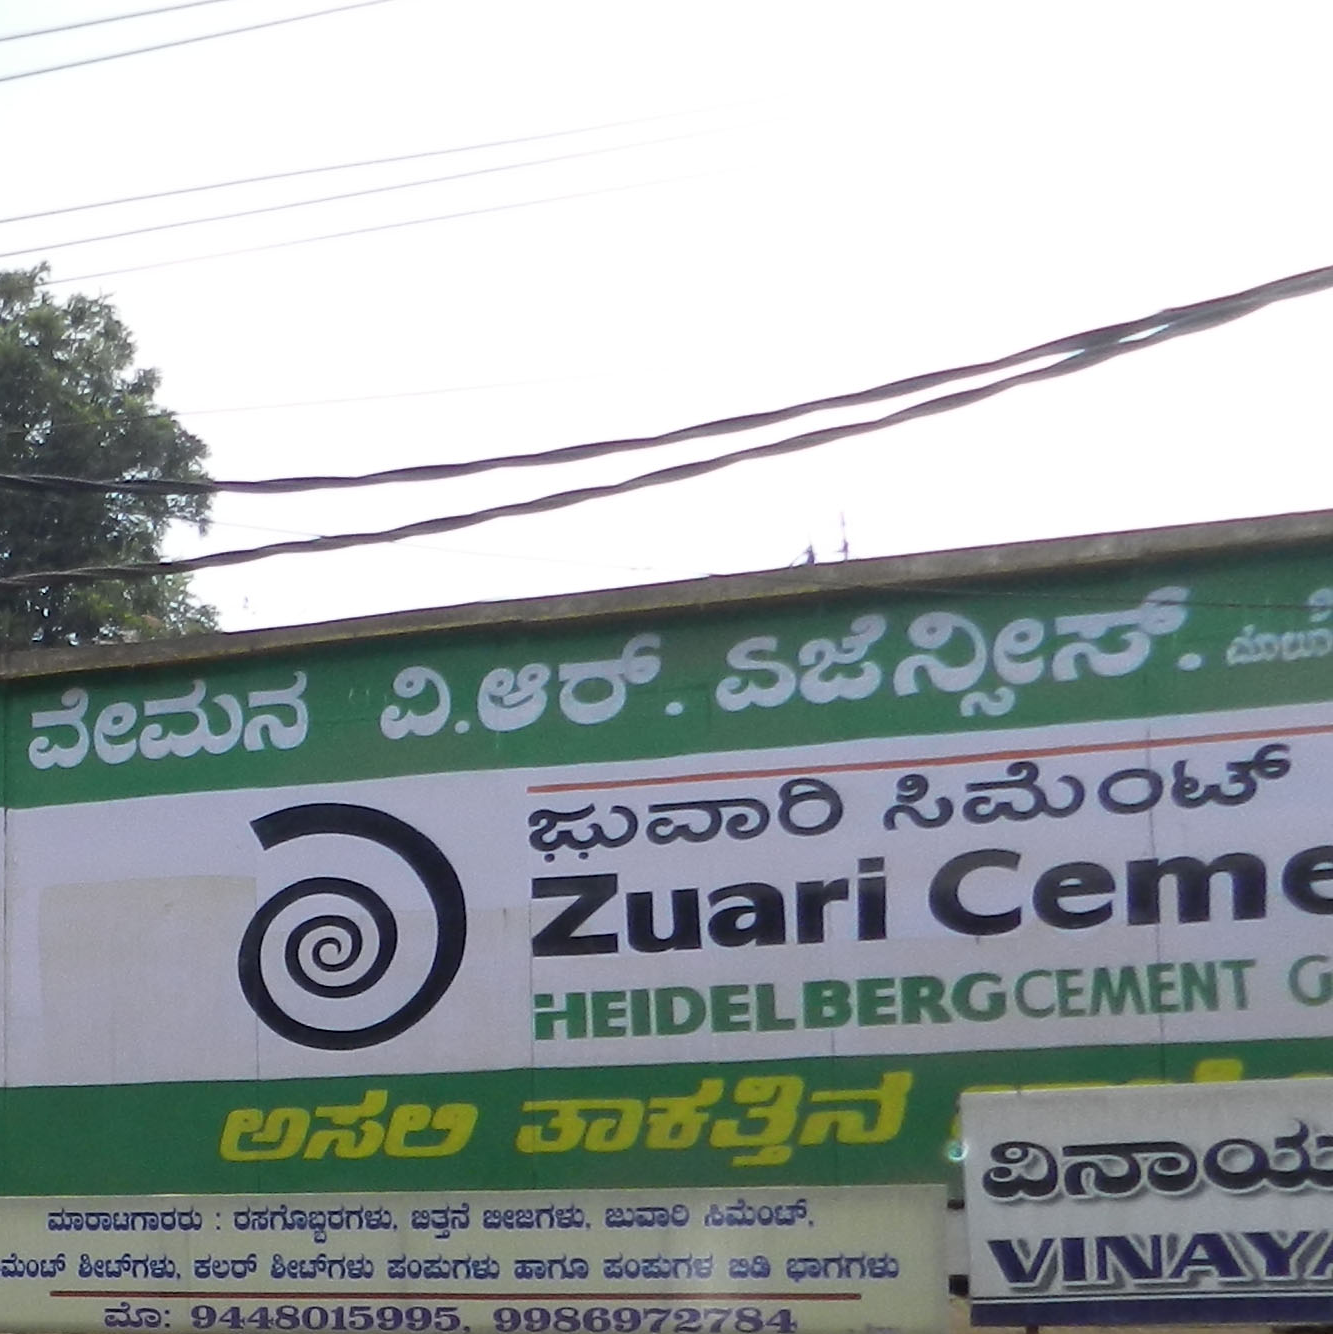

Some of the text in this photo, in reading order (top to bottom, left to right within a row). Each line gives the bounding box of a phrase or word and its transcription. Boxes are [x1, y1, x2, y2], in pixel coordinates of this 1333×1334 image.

[28, 670, 309, 770] ವೇಮನ
[883, 743, 1290, 832] ಸಿಮೆಂಟ್
[531, 857, 888, 958] Zuari
[218, 1089, 479, 1165] ಅಸಲಿ
[515, 1069, 915, 1168] ತಾಕತ್ತಿನ
[411, 1202, 470, 1239] ಬಿತ್ತನೆ
[605, 1202, 690, 1230] ಜುವಾರಿ
[194, 1253, 257, 1280] ಕಲರ್
[387, 1253, 500, 1280] ಪಂಪುಗಳು
[514, 1255, 589, 1280] ಹಾಗೂ
[604, 1253, 715, 1280] ಪಂಪುಗಳ
[729, 1254, 771, 1279] ಬಿಡಿ
[786, 1252, 901, 1283] ಭಾಗಗಳು
[988, 1231, 1333, 1284] VINAY
[493, 1305, 799, 1334] 9986972784
